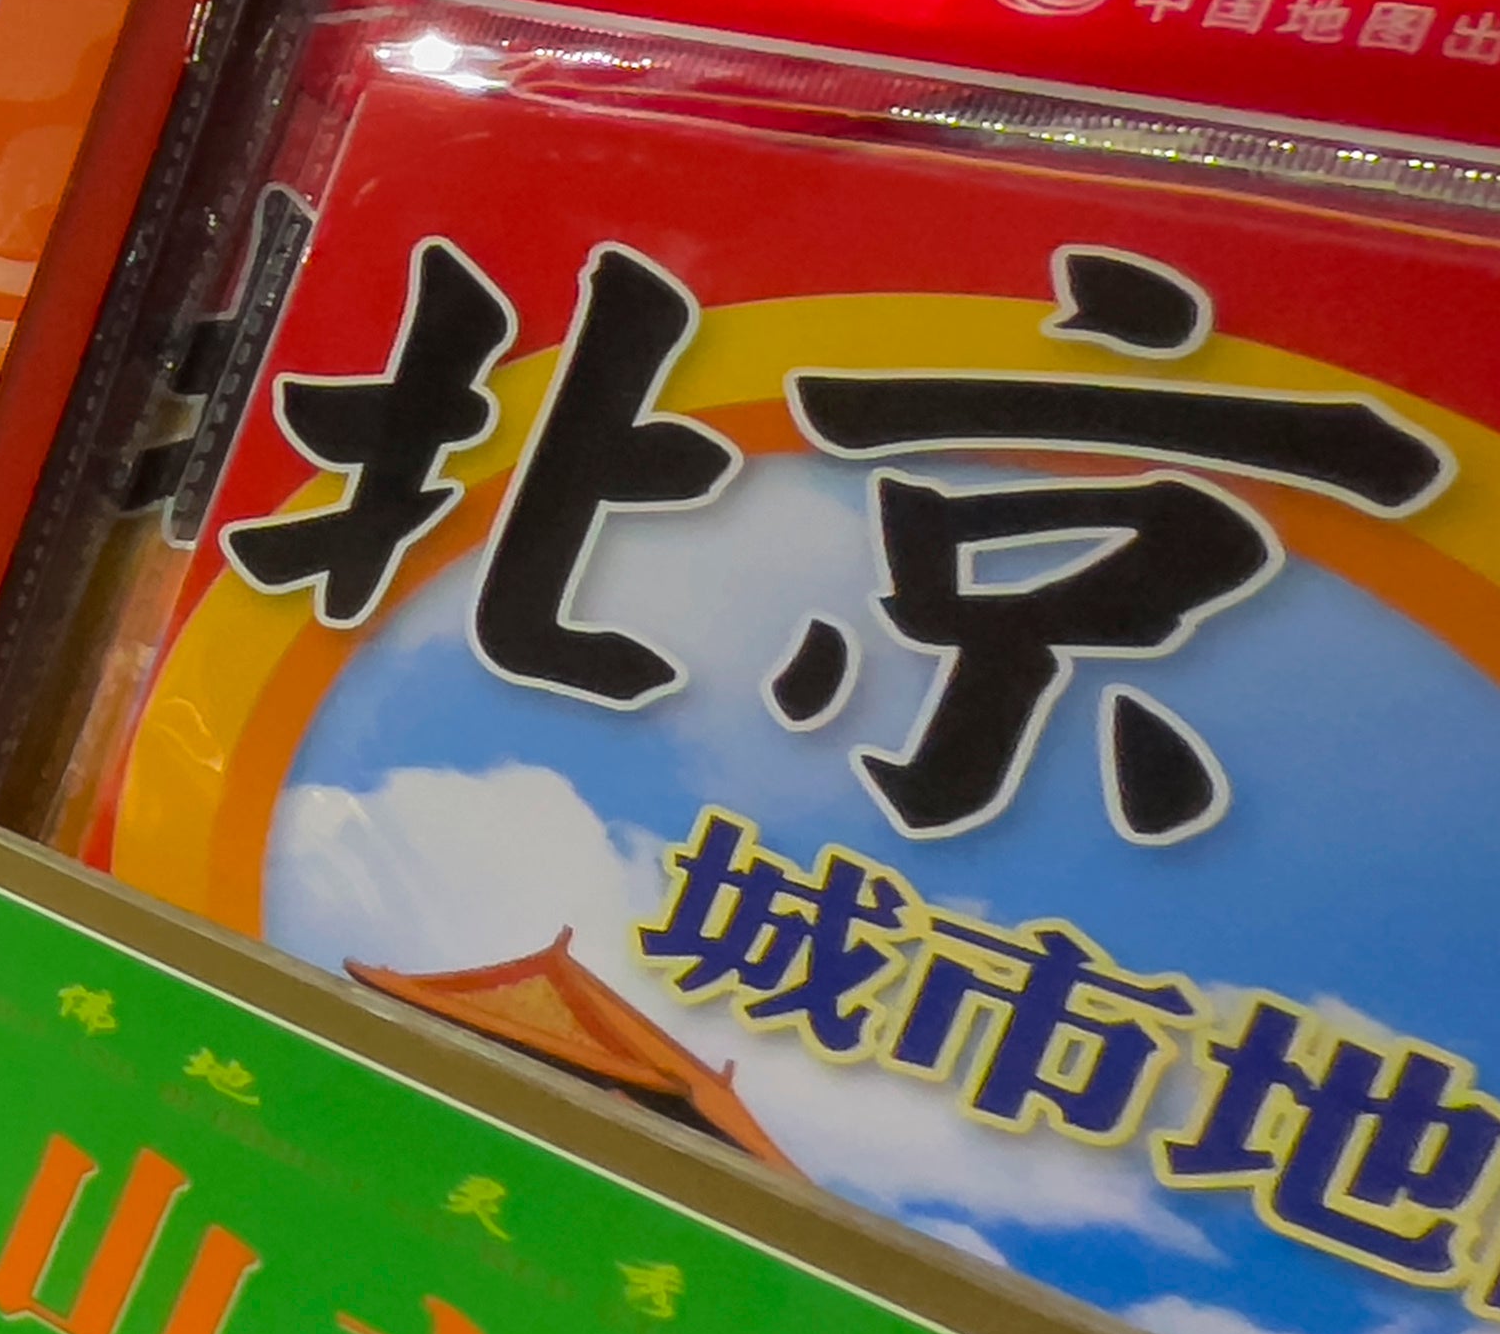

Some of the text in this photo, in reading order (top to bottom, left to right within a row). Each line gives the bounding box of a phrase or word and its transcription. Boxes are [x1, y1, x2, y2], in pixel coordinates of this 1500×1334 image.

[220, 238, 1456, 845] 北京
[636, 807, 1500, 1317] 城市地
